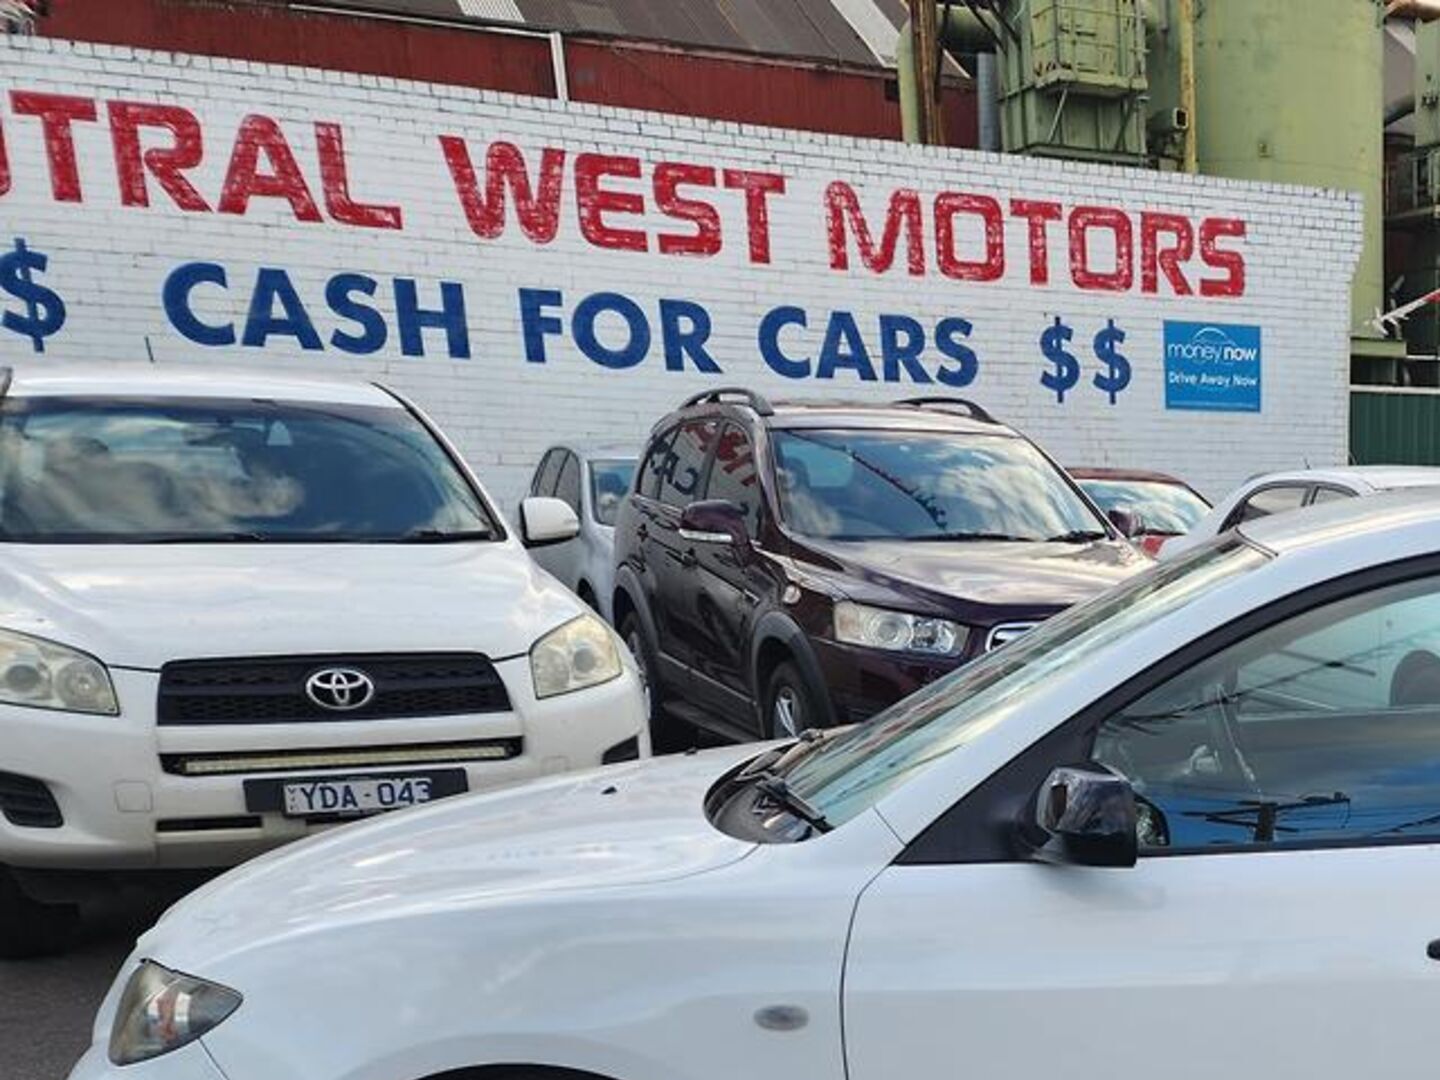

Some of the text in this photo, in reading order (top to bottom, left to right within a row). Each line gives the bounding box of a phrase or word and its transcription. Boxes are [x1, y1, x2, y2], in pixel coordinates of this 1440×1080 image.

[0, 90, 1247, 298] TRAL WEST MOTORS
[162, 261, 471, 360] CASH
[518, 287, 723, 374] FOR
[758, 306, 978, 387] CARS
